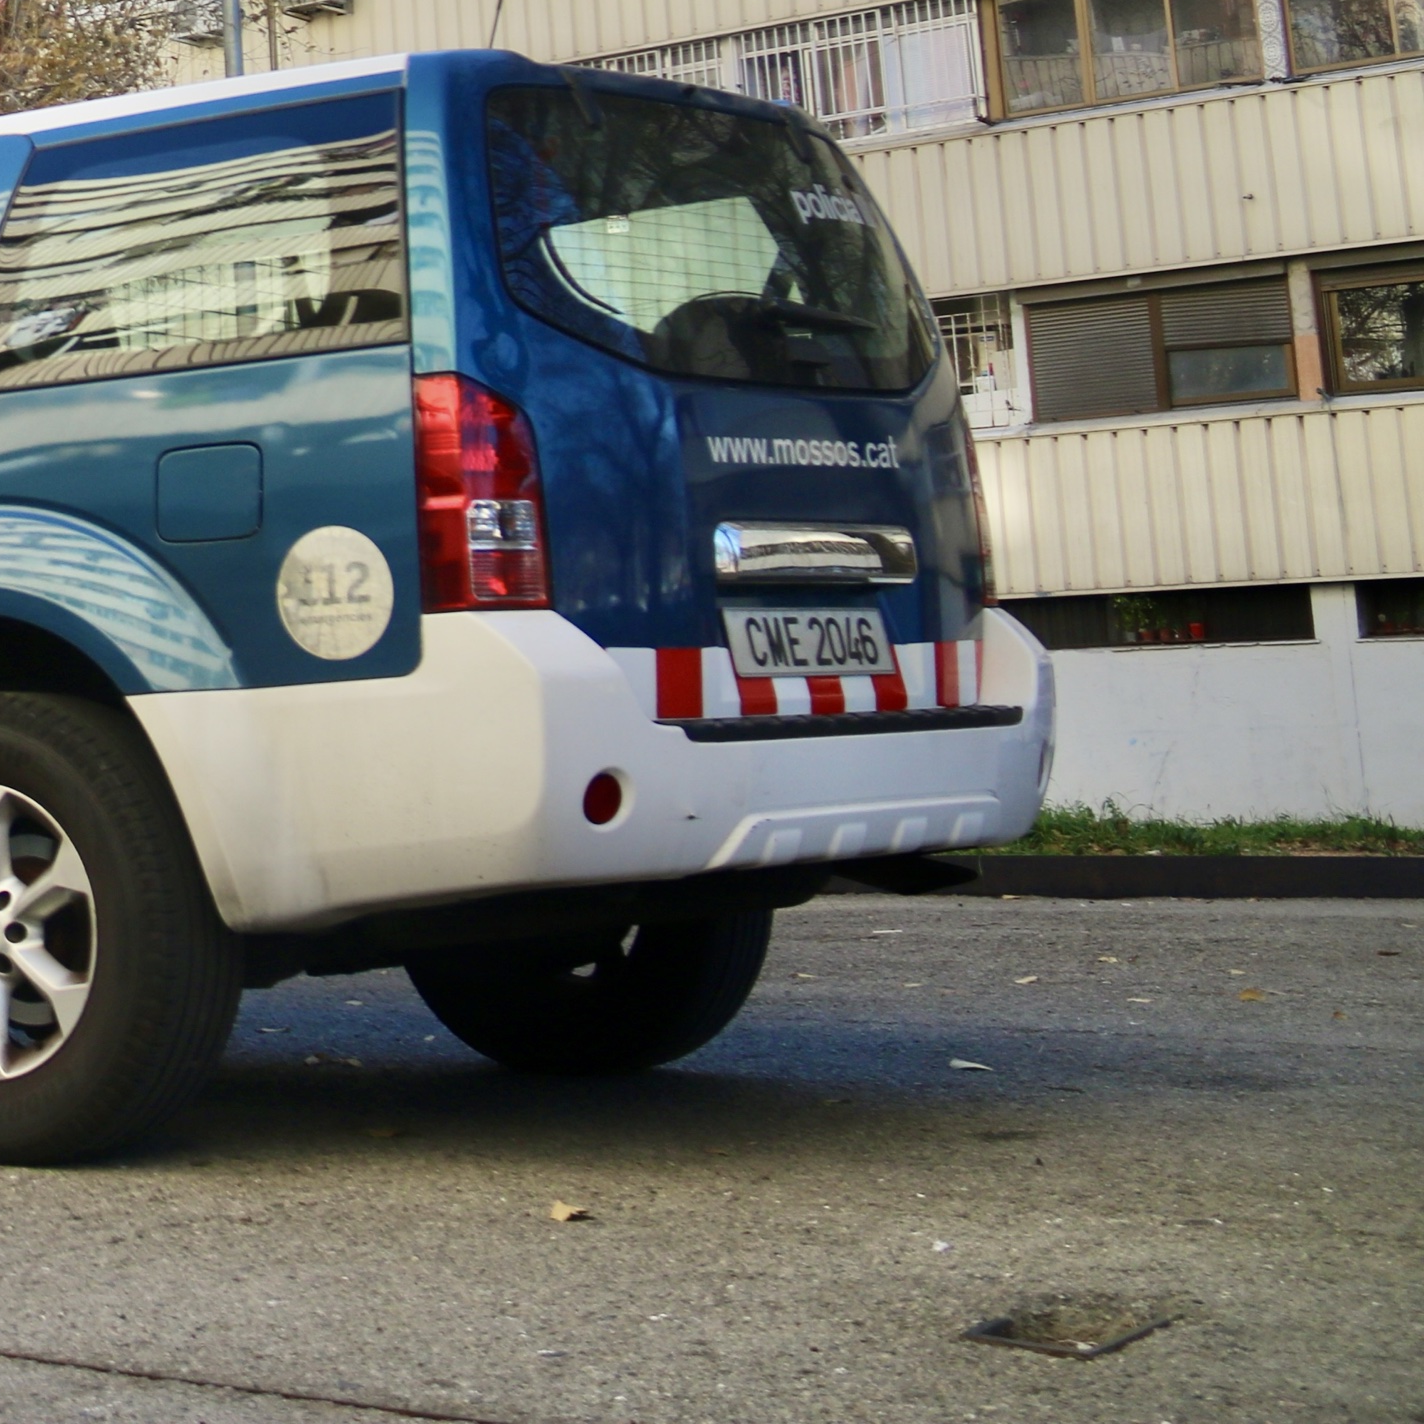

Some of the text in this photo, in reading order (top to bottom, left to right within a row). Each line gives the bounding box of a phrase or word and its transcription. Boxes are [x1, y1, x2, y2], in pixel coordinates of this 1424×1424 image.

[790, 183, 865, 224] policia
[708, 435, 900, 468] www.mossos.cat
[745, 617, 879, 667] CME 2046
